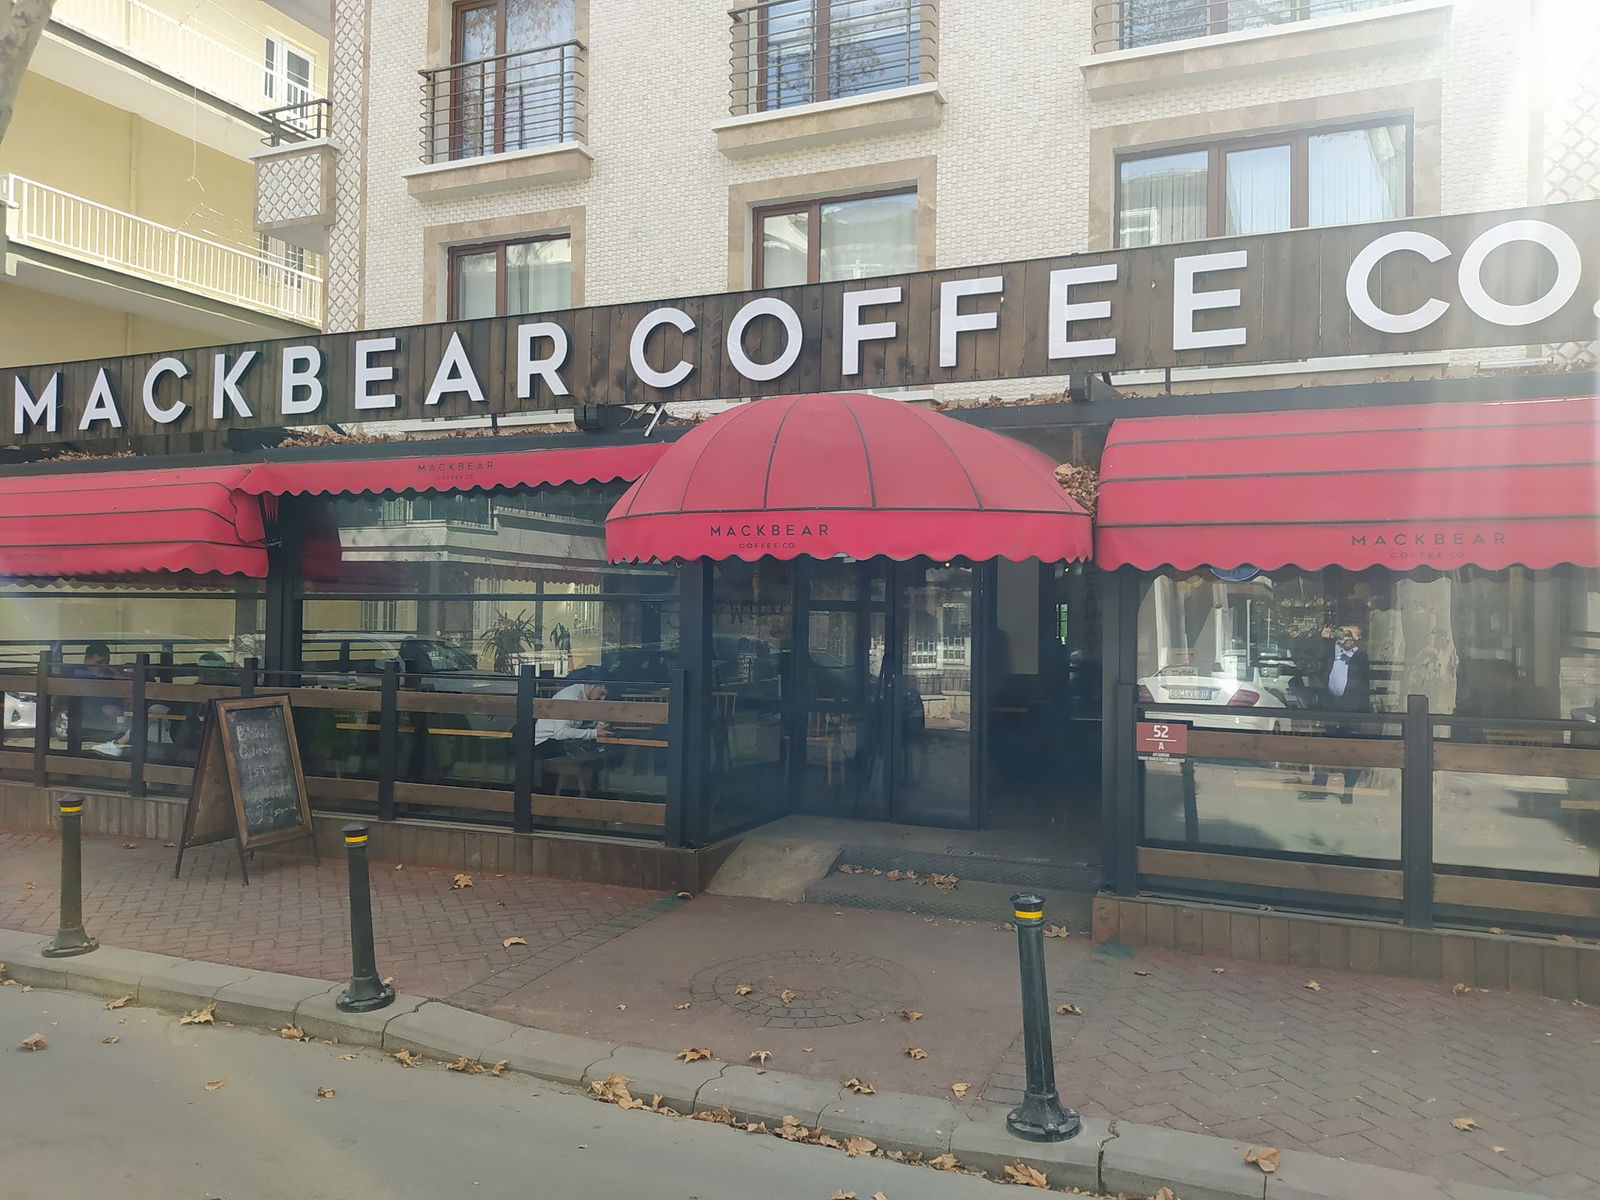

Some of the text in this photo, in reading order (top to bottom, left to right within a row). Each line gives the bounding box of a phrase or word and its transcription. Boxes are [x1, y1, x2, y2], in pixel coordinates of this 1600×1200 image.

[14, 322, 570, 435] MACKBEAR
[629, 250, 1248, 389] COFFEE
[417, 460, 495, 472] MACKBEAR
[710, 524, 829, 537] MACKBEAR
[1351, 532, 1505, 546] MACKBEAR
[1153, 725, 1169, 738] 52
[1158, 742, 1165, 750] A
